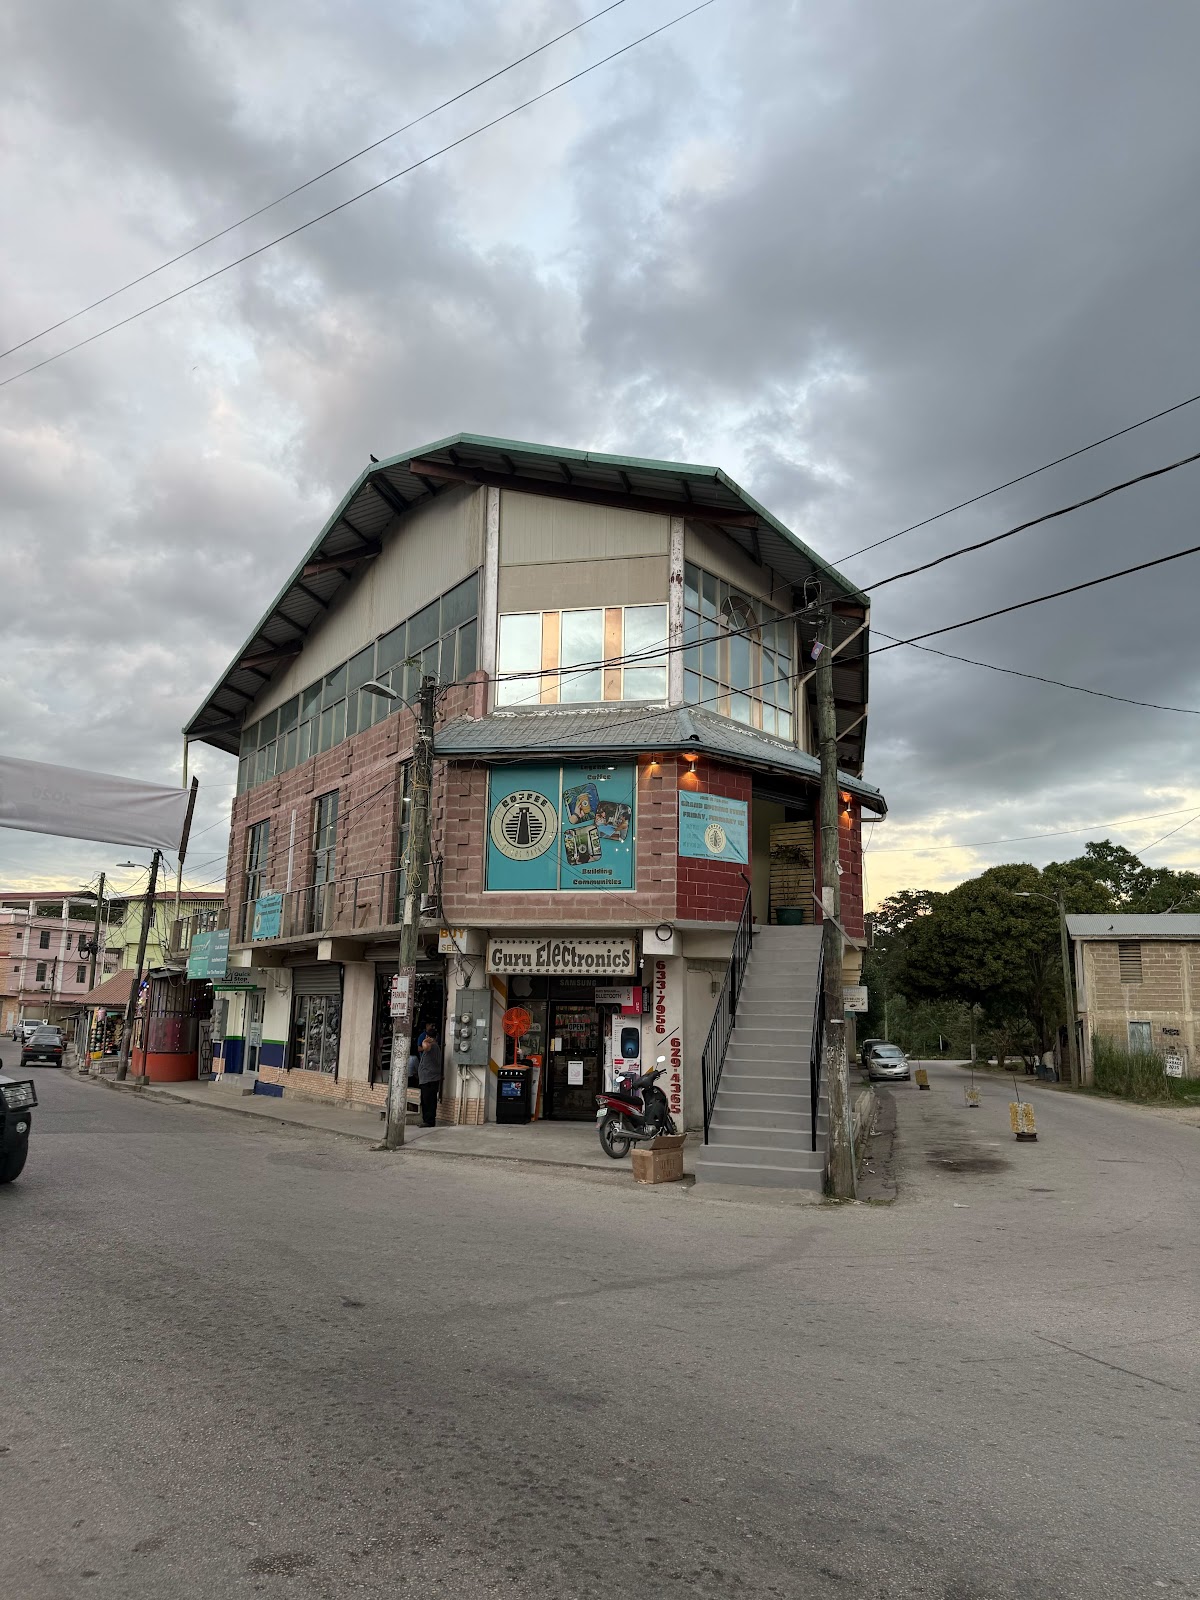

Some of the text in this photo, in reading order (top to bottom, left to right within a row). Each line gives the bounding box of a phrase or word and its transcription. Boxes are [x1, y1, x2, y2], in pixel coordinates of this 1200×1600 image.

[501, 793, 548, 808] COFFEE
[440, 928, 465, 938] BUY
[492, 948, 532, 967] Guru
[392, 991, 407, 999] PARKING
[656, 960, 666, 1034] 633-7956
[391, 1002, 407, 1010] ANYTIME
[670, 1038, 681, 1114] 629-4365
